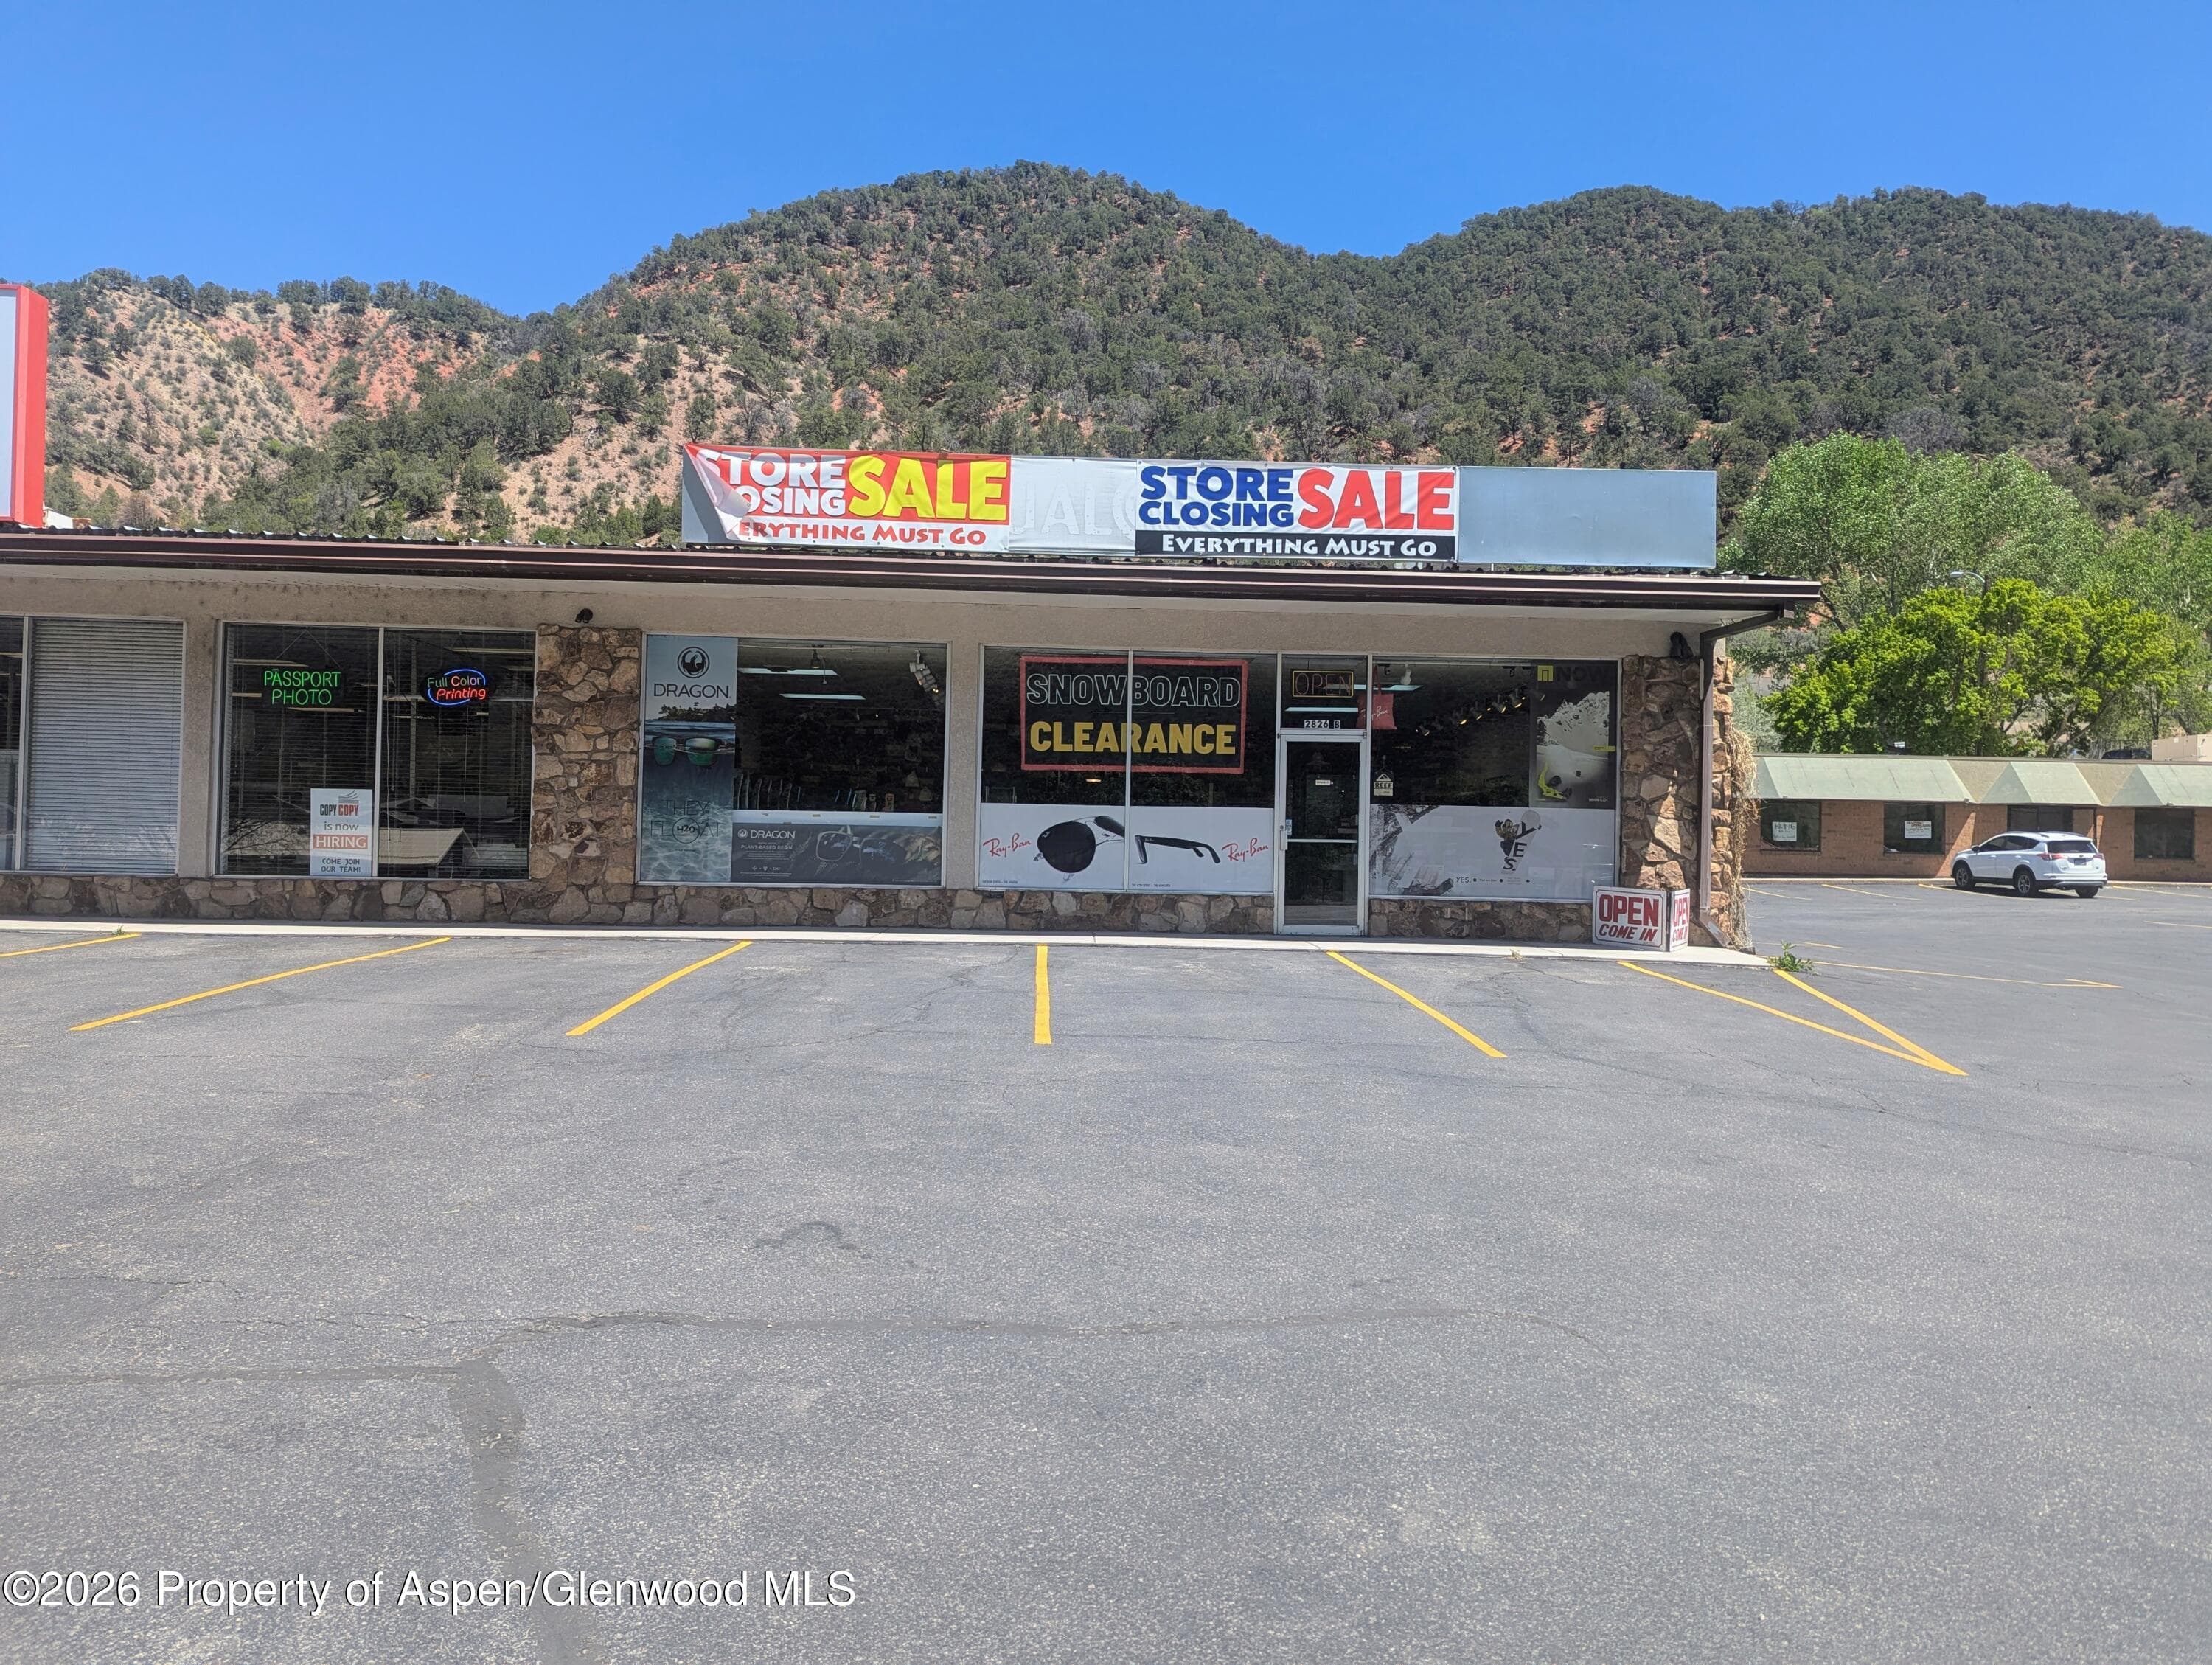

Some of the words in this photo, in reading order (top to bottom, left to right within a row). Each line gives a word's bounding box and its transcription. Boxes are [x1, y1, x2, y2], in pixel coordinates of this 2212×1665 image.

[848, 455, 1008, 521] SALE
[1140, 465, 1294, 502] STORE
[735, 485, 846, 516] OSING
[1297, 468, 1455, 530] SALE
[1138, 501, 1294, 527] CLOSING
[739, 522, 866, 541] ERYTHING
[872, 524, 944, 543] MUST
[949, 528, 987, 546] GO
[1162, 534, 1318, 555] EVERYTHING
[1325, 537, 1395, 555] MUST
[1401, 539, 1437, 556] GO
[264, 670, 341, 687] PASSPORT
[428, 677, 448, 688] Full
[451, 675, 483, 686] Color
[1295, 672, 1352, 695] OPEN
[271, 689, 332, 705] PHOTO
[436, 687, 487, 700] Printing
[653, 683, 729, 699] DRAGON
[1026, 674, 1241, 708] SNOWBOARD
[1305, 720, 1329, 729] 2826
[1335, 720, 1340, 729] B
[1030, 720, 1237, 755] CLEARANCE
[319, 804, 337, 816] COPY
[338, 804, 359, 816] COPY
[661, 799, 709, 816] THEY
[324, 821, 333, 831] is
[750, 830, 796, 839] DRAGON
[316, 835, 366, 849] HIRING
[983, 832, 1032, 858] Ray-Ban
[1221, 838, 1269, 862] Ray-Ban
[1599, 894, 1660, 928] OPEN
[1599, 923, 1638, 939] COME
[1638, 928, 1658, 942] IN
